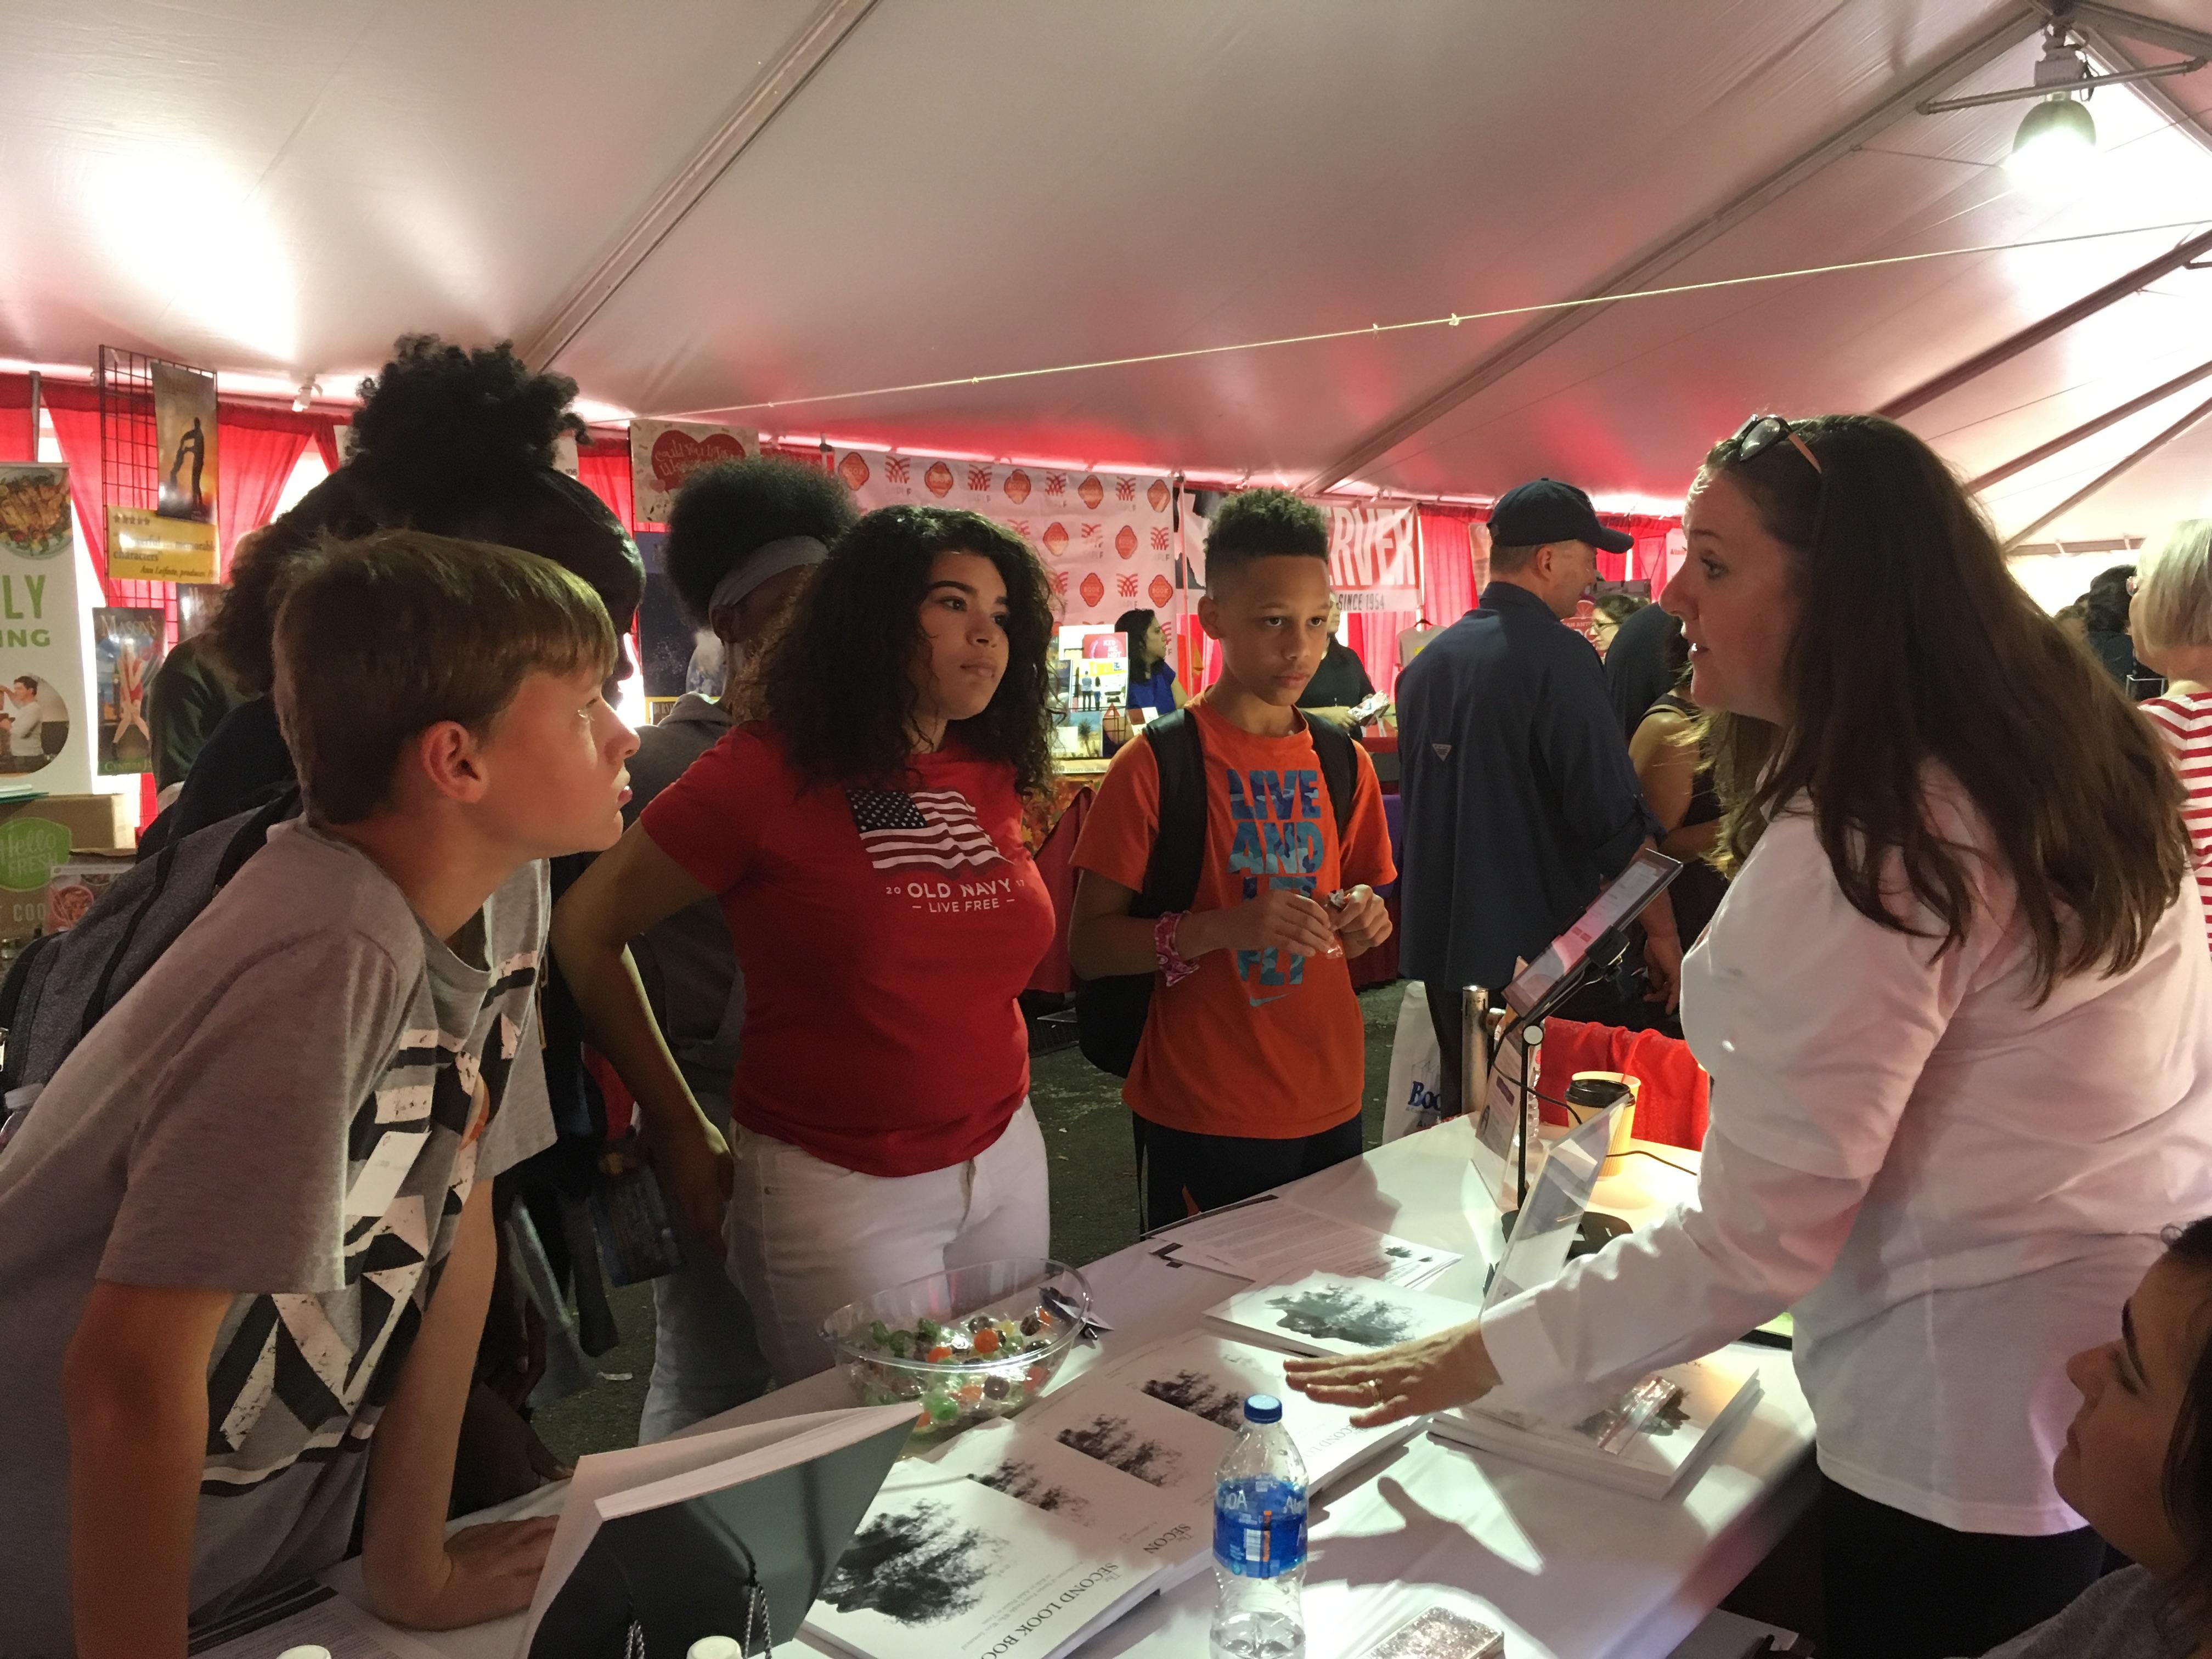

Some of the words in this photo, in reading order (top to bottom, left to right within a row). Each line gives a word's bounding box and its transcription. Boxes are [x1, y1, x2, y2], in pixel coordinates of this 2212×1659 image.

[2, 574, 46, 619] LY
[1338, 594, 1363, 611] SINCE
[1365, 594, 1385, 610] 1954
[1226, 770, 1321, 820] LIVE
[1227, 821, 1324, 875] AND
[907, 882, 951, 898] OLD
[960, 878, 1011, 898] NAVY
[929, 901, 960, 913] LIVE
[965, 898, 1000, 912] FREE
[1143, 1523, 1192, 1554] SECON
[1059, 1562, 1119, 1603] SECOND
[1014, 1602, 1063, 1637] LOOK
